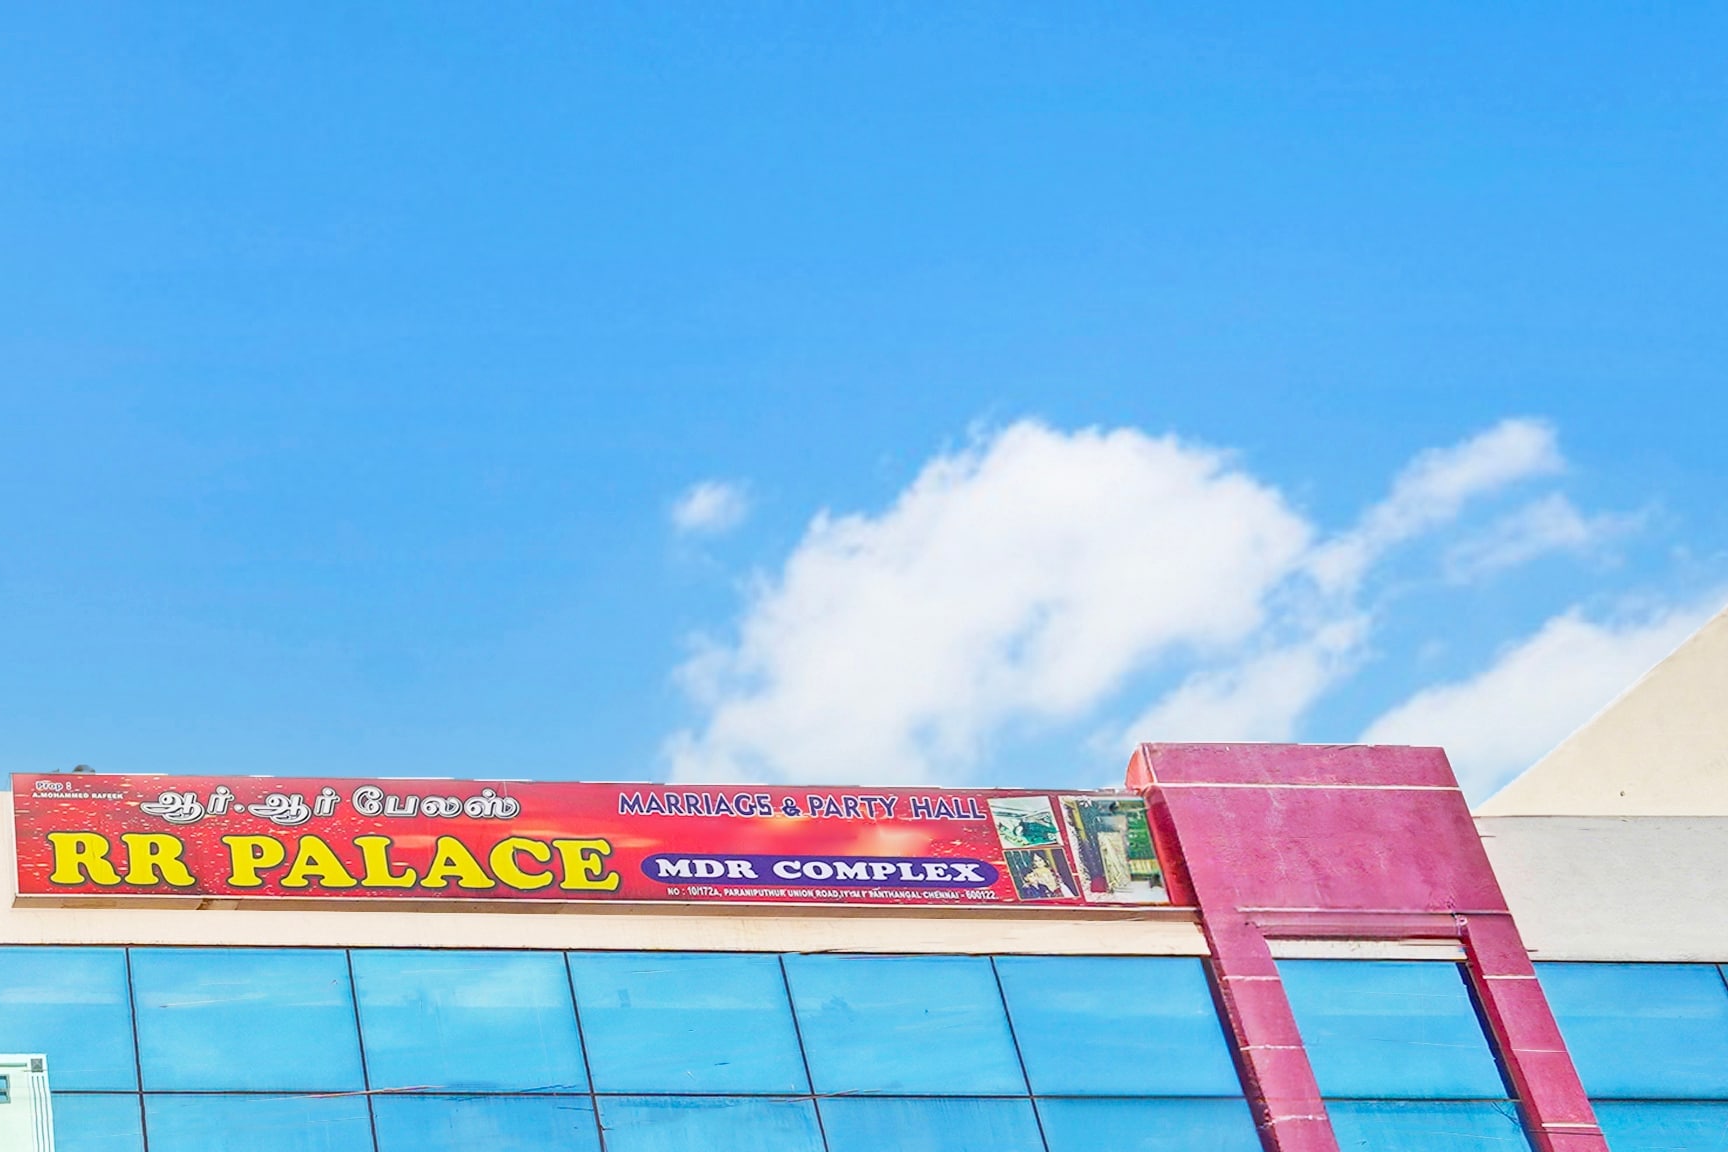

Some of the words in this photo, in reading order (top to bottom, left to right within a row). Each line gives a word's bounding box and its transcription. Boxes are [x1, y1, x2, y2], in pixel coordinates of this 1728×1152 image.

[91, 792, 124, 800] RAFEEK
[351, 785, 521, 819] பேலஸ்
[781, 797, 802, 818] &
[807, 794, 897, 819] PARTY
[910, 796, 987, 820] HALL
[47, 832, 195, 888] RR
[221, 834, 621, 892] PALACE
[655, 858, 759, 879] MDR
[772, 860, 986, 882] COMPLEX
[787, 889, 814, 898] UNION
[923, 890, 960, 899] CHENNAI
